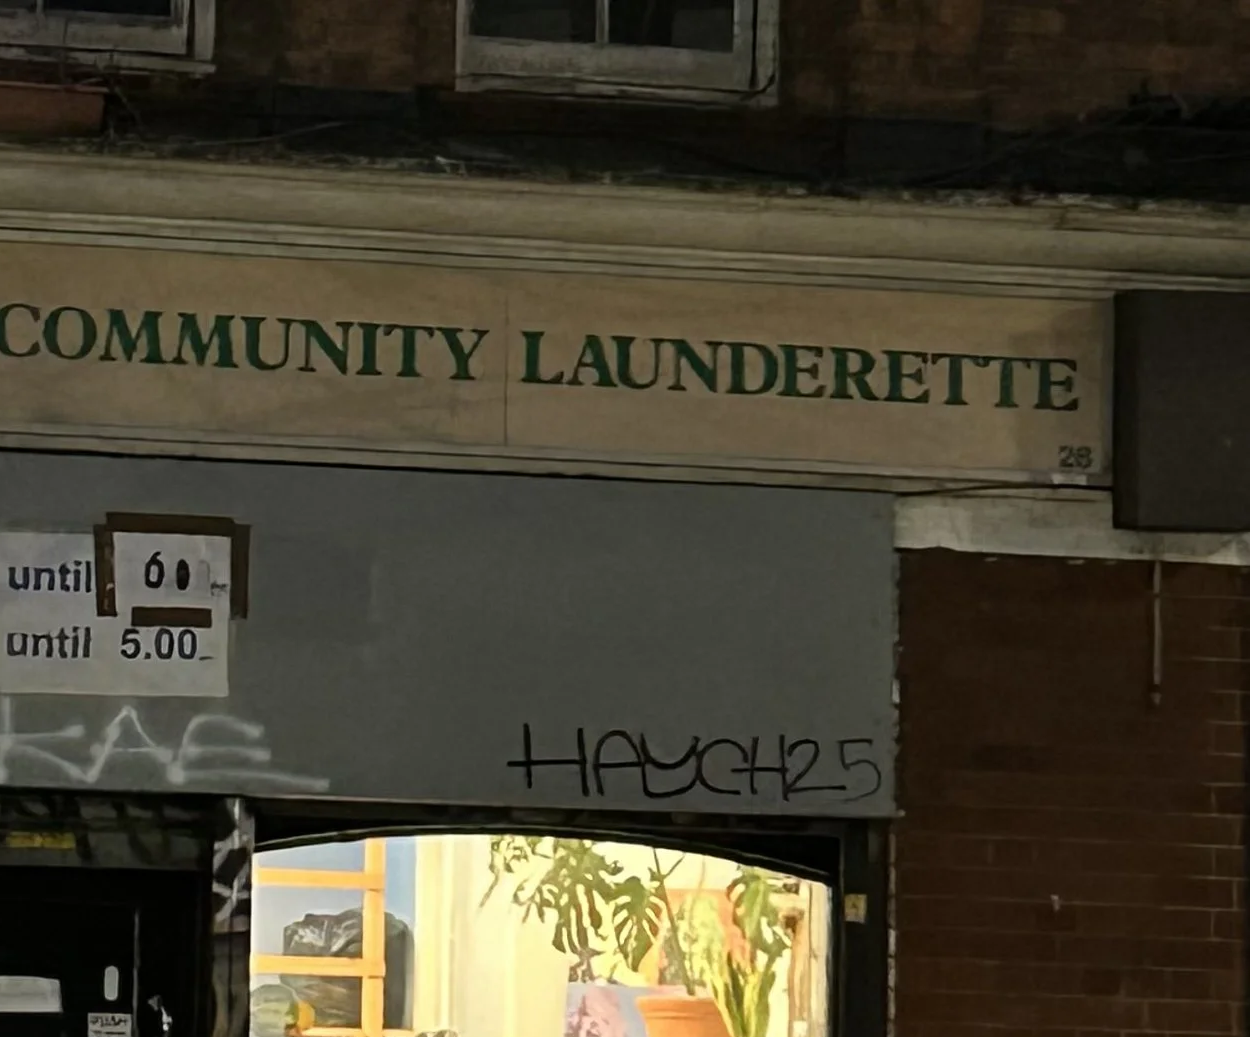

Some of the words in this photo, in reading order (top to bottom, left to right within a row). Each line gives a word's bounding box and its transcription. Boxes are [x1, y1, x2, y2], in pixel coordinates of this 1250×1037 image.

[521, 330, 1080, 412] LAUNDERETTE
[1058, 445, 1094, 469] 28
[7, 559, 93, 594] until
[6, 626, 92, 659] until
